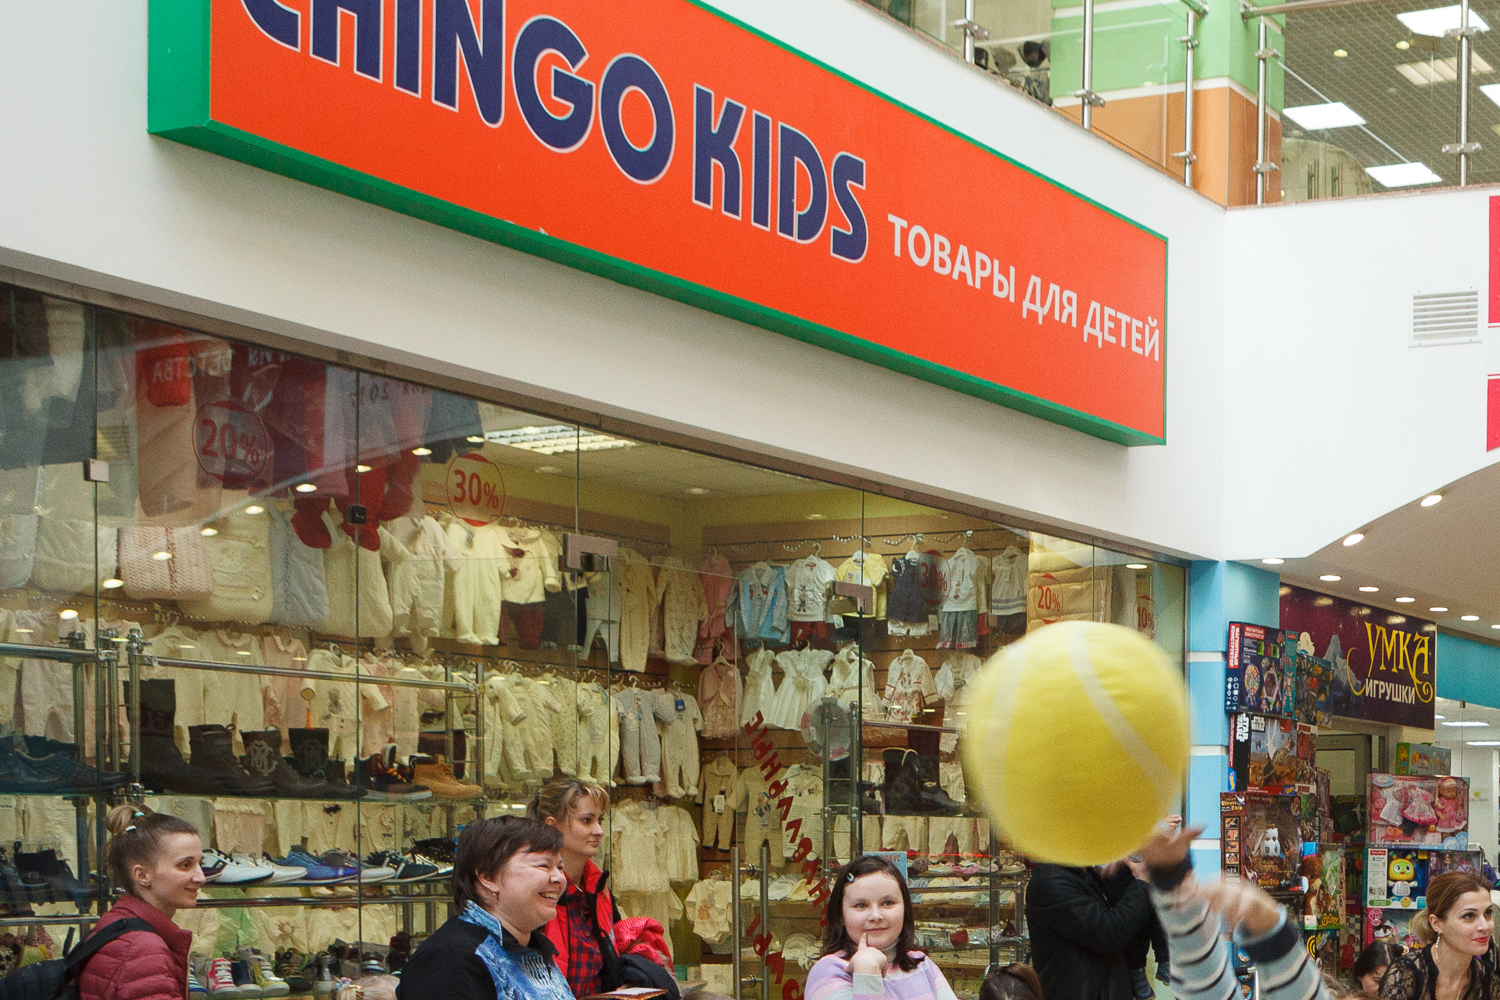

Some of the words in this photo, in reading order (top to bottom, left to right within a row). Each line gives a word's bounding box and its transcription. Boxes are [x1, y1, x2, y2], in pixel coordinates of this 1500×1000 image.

[693, 82, 869, 264] KIDS
[887, 213, 1016, 304] ТОВАРЫ
[1022, 274, 1078, 328] ДЛЯ
[1083, 300, 1160, 362] ДЕТЕЙ
[201, 418, 260, 466] 20%
[453, 468, 499, 509] 30%
[920, 561, 949, 593] 30%
[1037, 585, 1061, 613] 20%
[1348, 621, 1433, 703] УМКА
[1365, 678, 1416, 705] ИГРУШКИ
